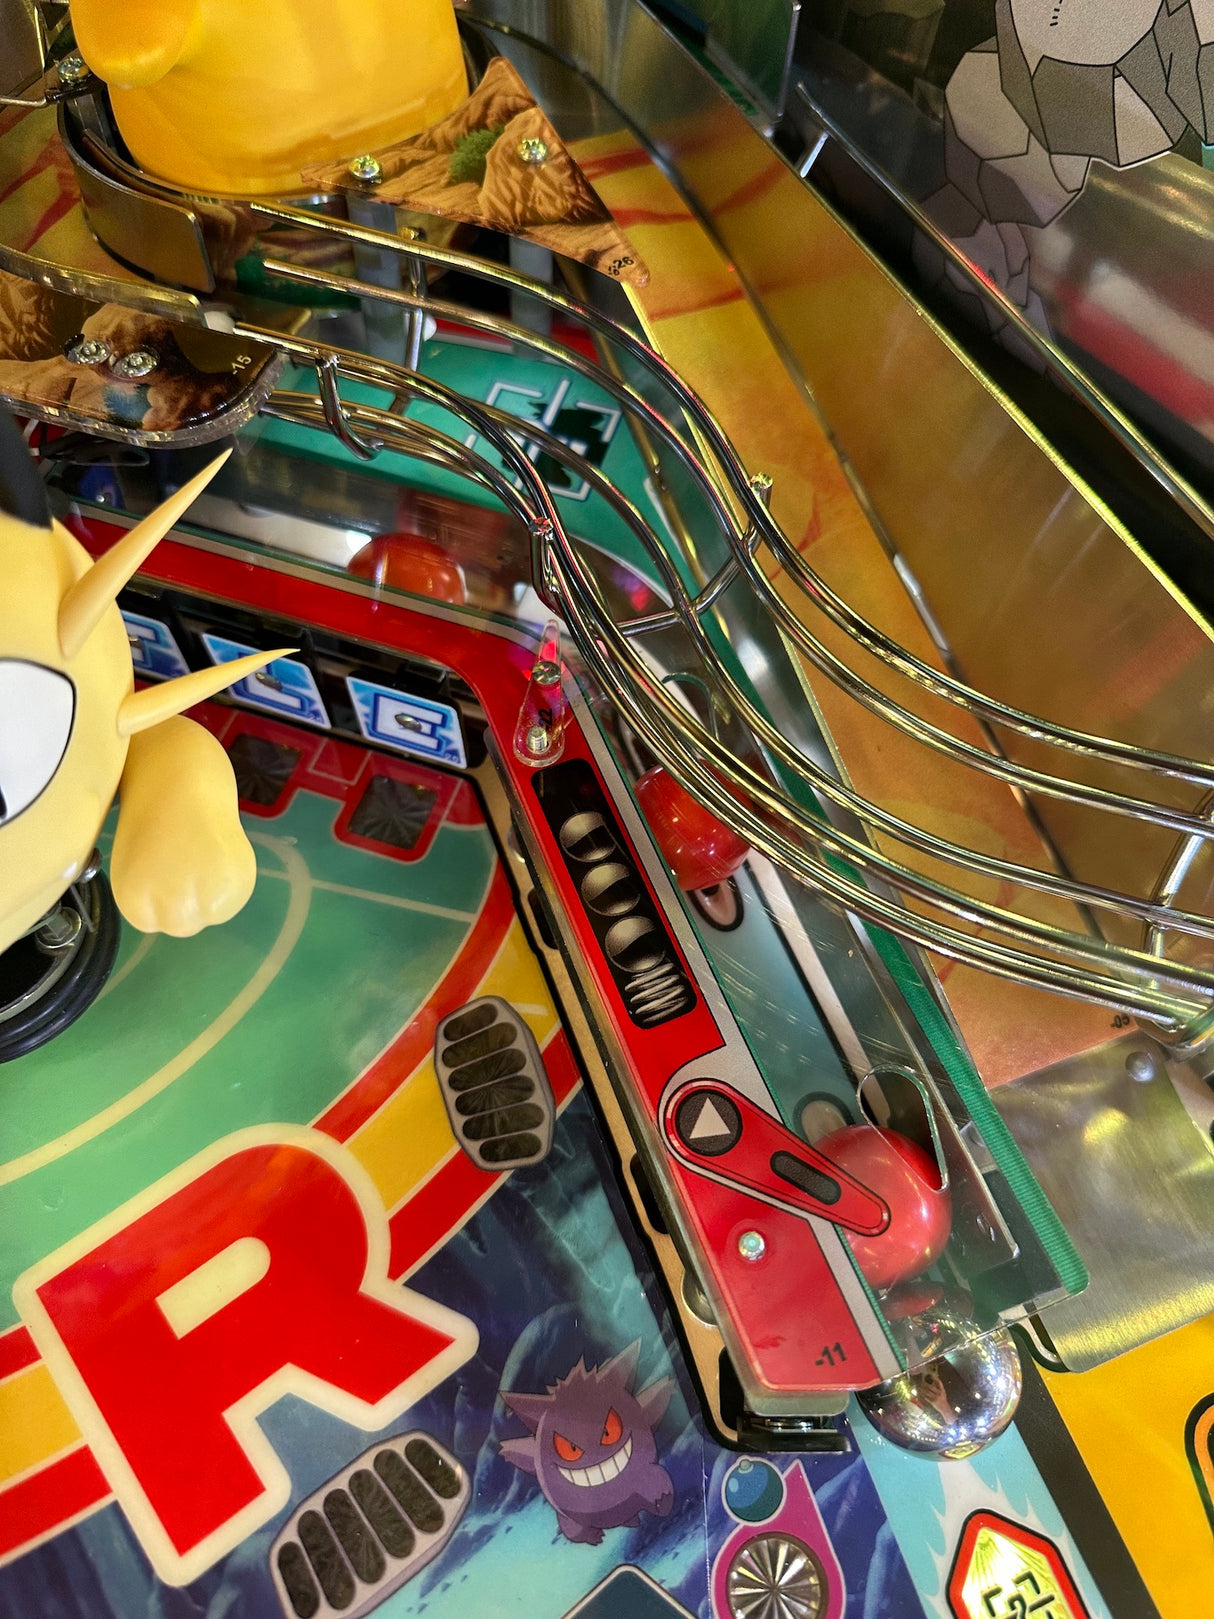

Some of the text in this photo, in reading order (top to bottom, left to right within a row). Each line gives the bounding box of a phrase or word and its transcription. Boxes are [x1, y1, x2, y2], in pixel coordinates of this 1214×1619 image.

[232, 355, 252, 375] -15
[372, 692, 448, 755] E
[14, 1122, 479, 1587] R
[815, 1342, 847, 1366] -11
